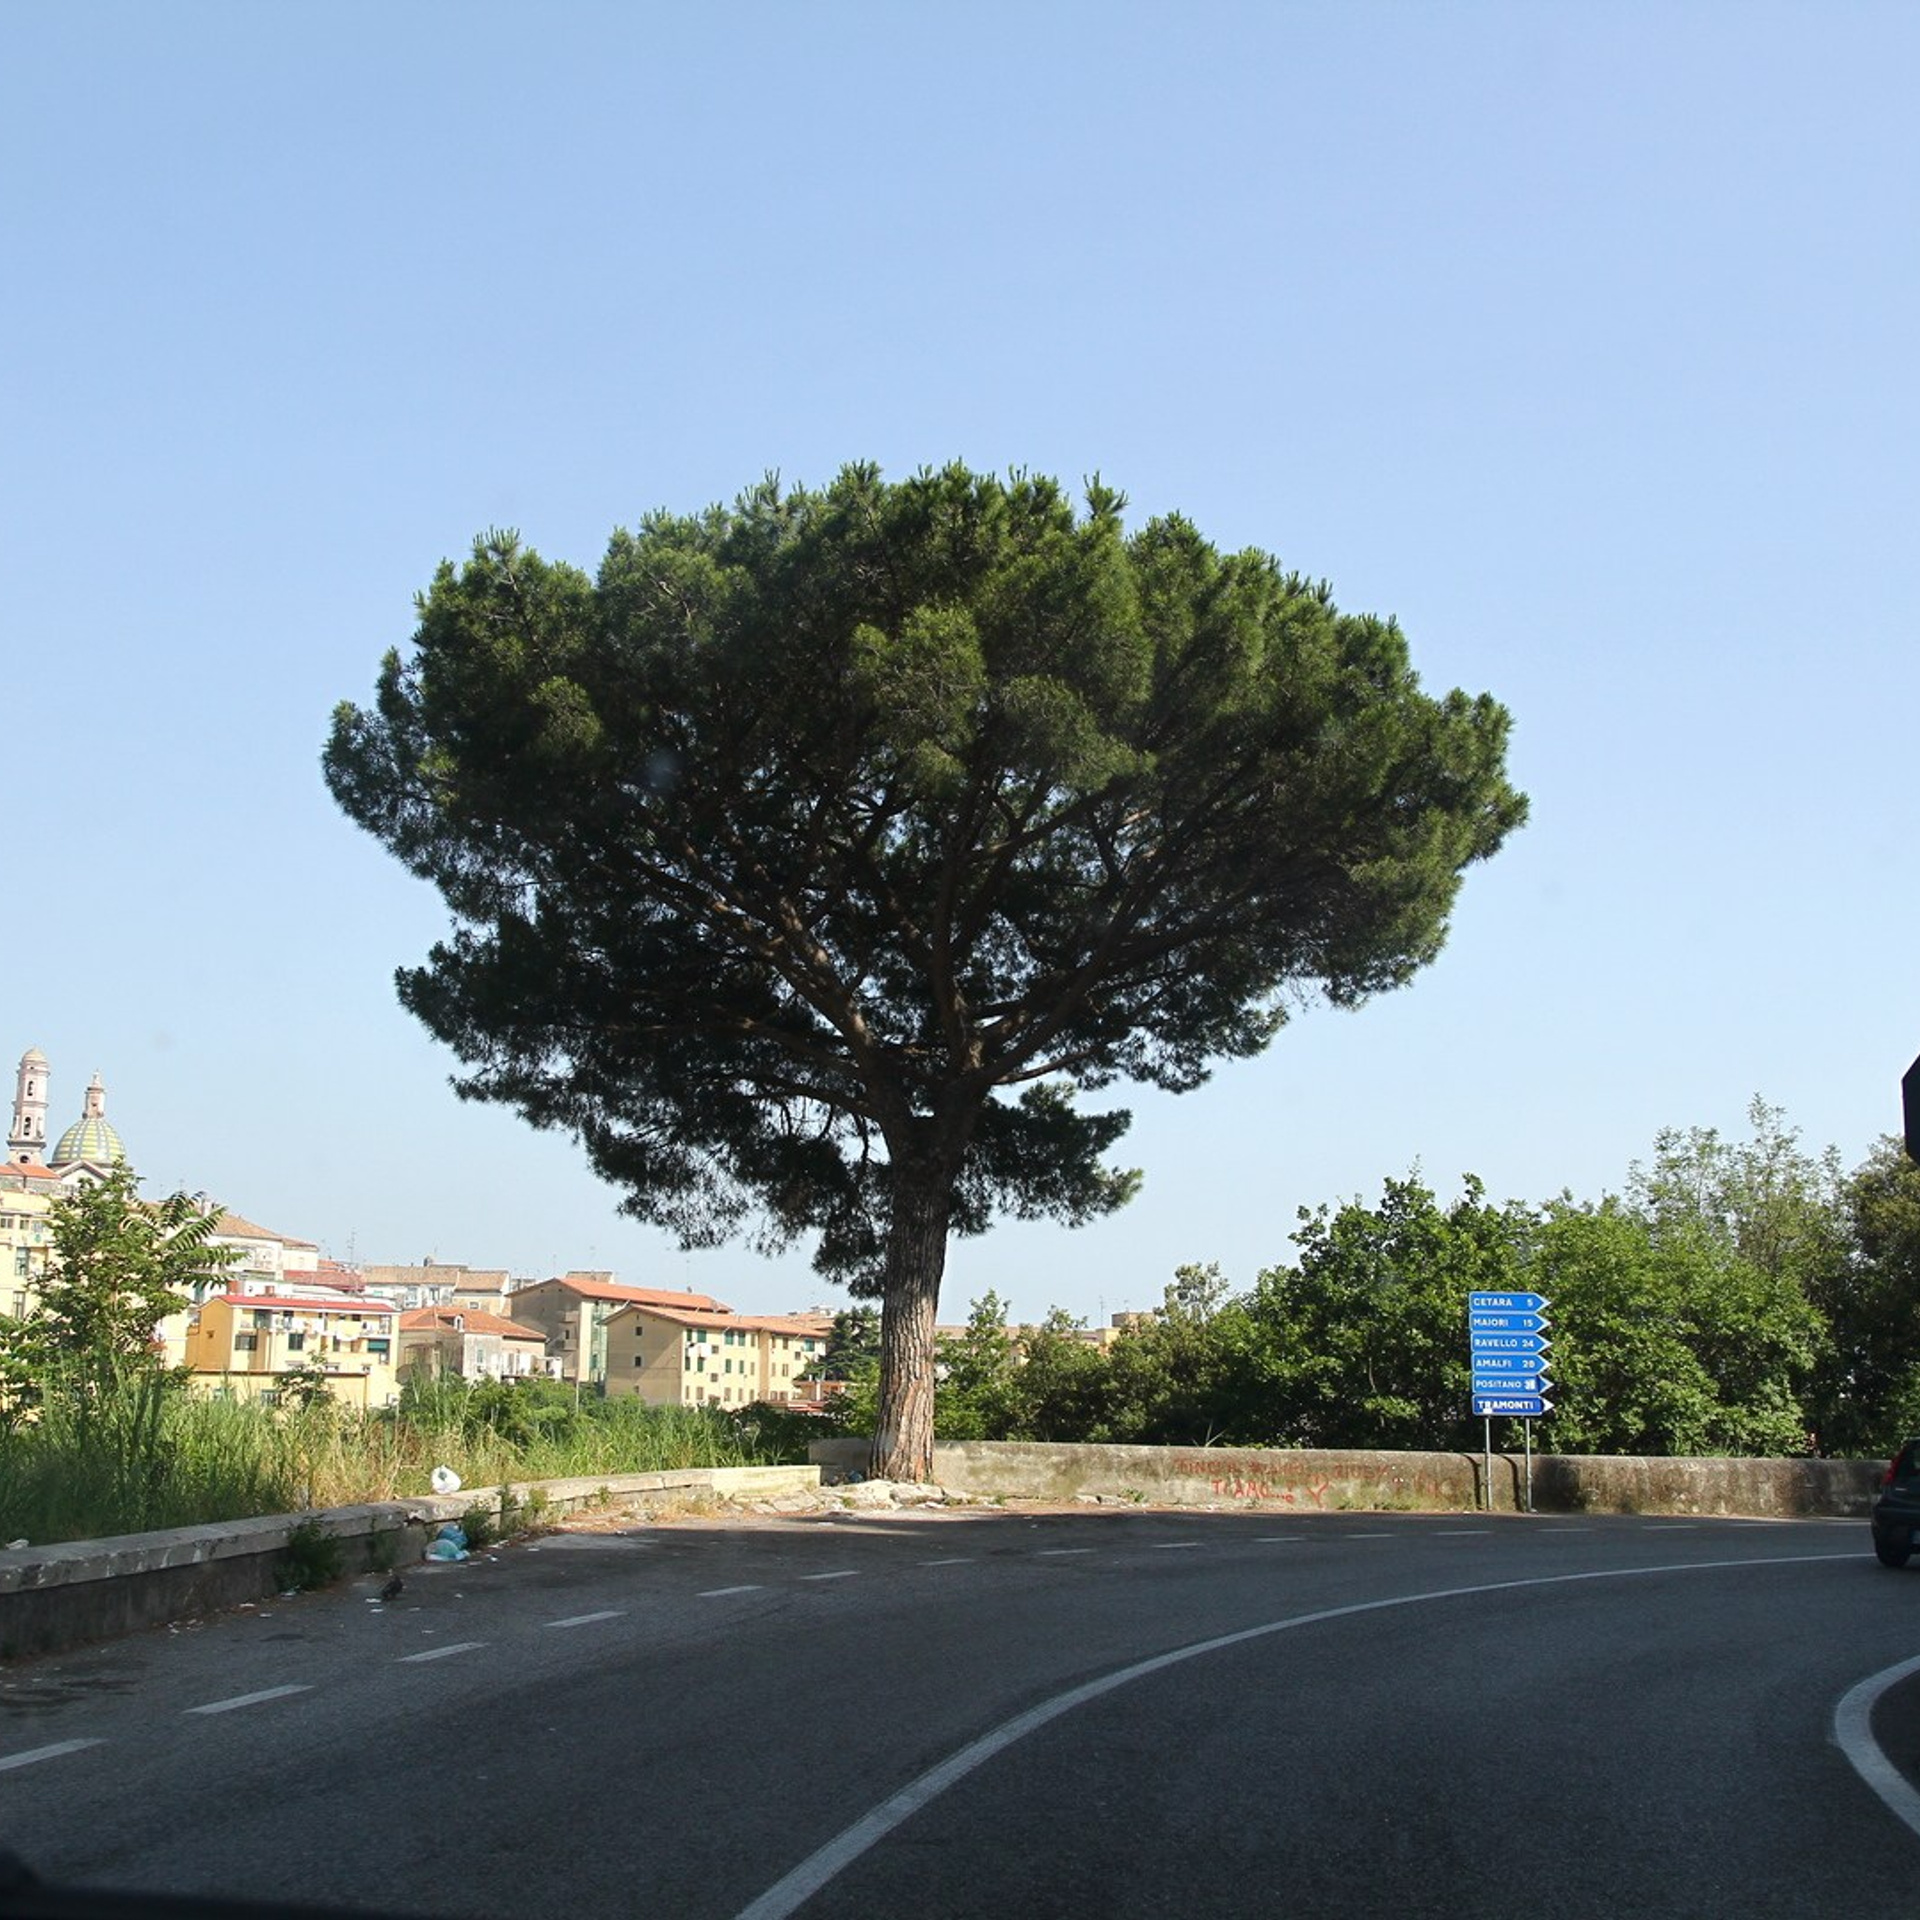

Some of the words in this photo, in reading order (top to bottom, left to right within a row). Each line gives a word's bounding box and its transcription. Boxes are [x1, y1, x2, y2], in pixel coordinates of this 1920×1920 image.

[1473, 1298, 1512, 1307] CETARA
[1526, 1298, 1534, 1307] 5
[1473, 1318, 1509, 1327] MAIORI
[1523, 1318, 1534, 1327] 15
[1474, 1339, 1518, 1347] RAVELLO
[1521, 1339, 1534, 1348] 24
[1475, 1359, 1512, 1368] AMALFI
[1475, 1380, 1521, 1388] POSITANO
[1477, 1400, 1533, 1409] TRAMONTI
